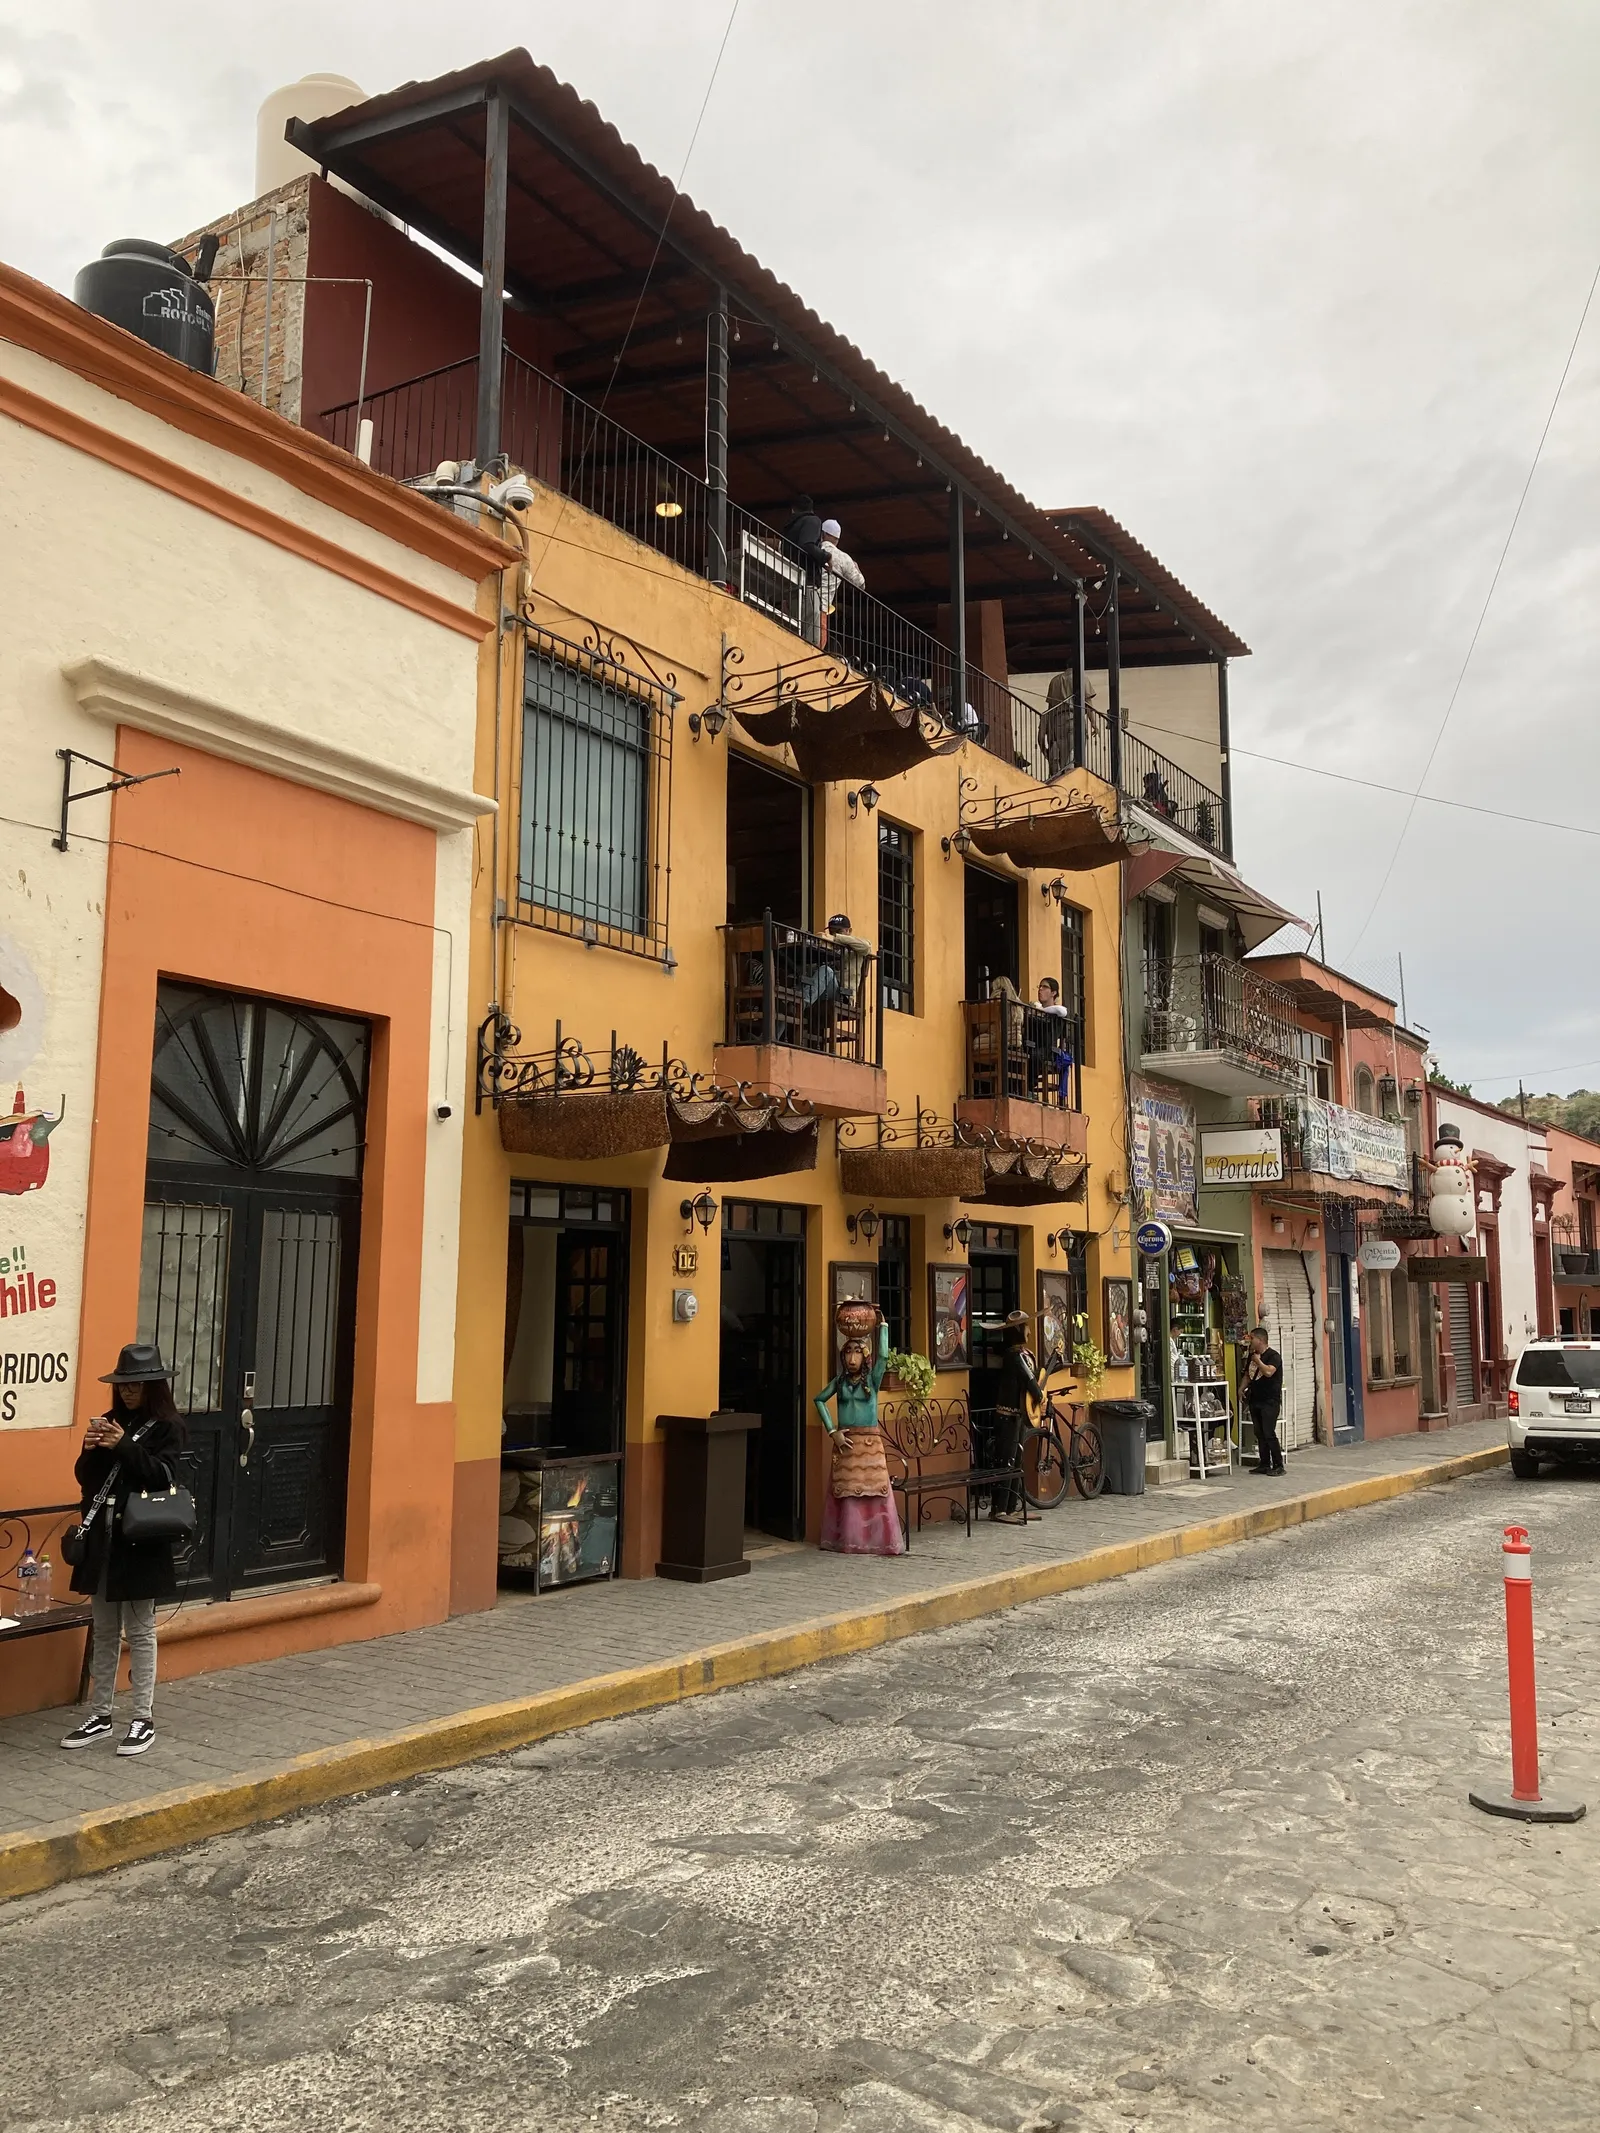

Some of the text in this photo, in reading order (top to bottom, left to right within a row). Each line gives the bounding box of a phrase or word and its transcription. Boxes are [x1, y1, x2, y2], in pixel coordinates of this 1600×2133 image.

[1216, 1151, 1279, 1179] Portales
[1137, 1235, 1164, 1244] Corona
[680, 1253, 696, 1268] 17
[0, 1352, 69, 1385] RIDOS
[0, 1390, 17, 1421] S
